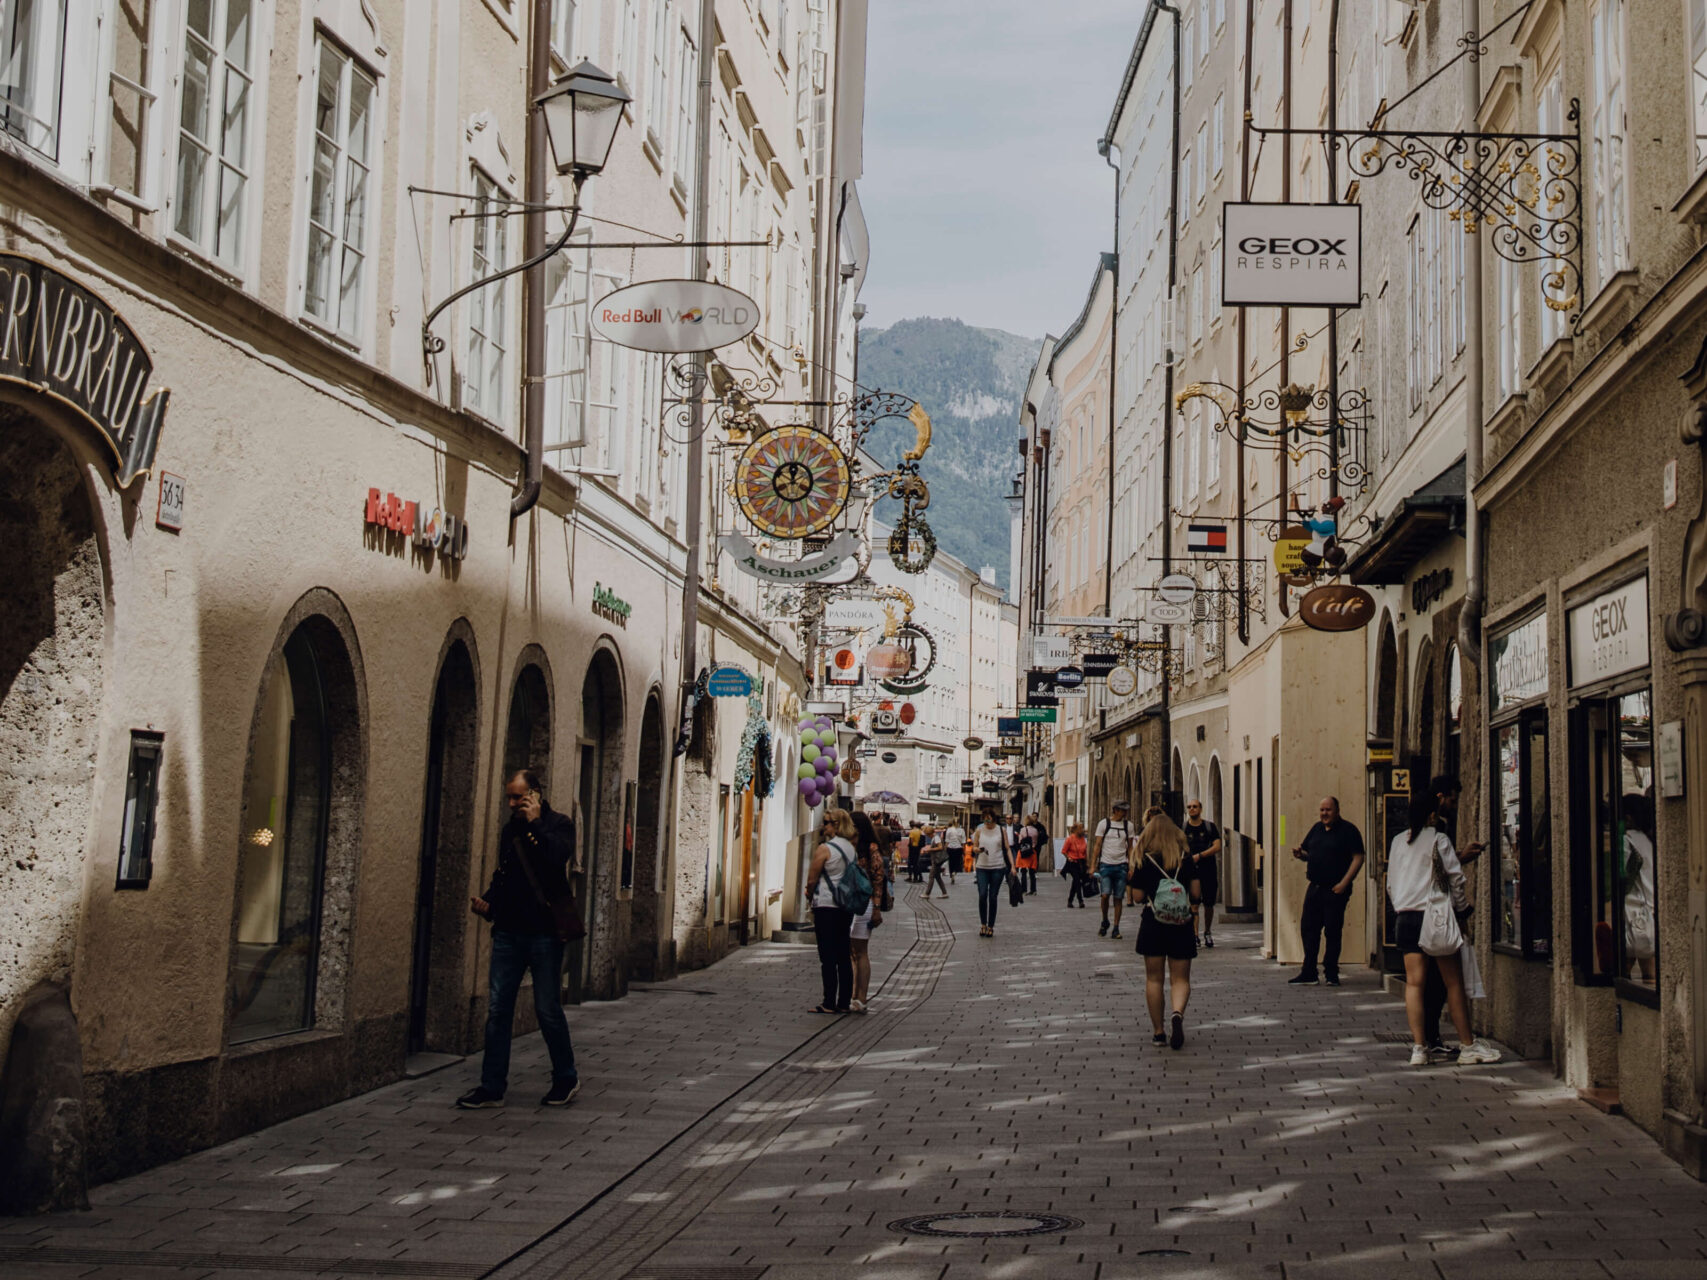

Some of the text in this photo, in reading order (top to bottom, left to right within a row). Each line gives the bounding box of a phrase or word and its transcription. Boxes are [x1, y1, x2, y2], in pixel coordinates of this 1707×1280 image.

[1238, 237, 1347, 255] GEOX
[1237, 257, 1347, 270] RESPIRA
[602, 308, 631, 324] Red
[634, 308, 662, 324] Bull
[742, 555, 839, 578] Aschauer
[1312, 596, 1365, 616] Café
[1592, 596, 1628, 642] GEOX
